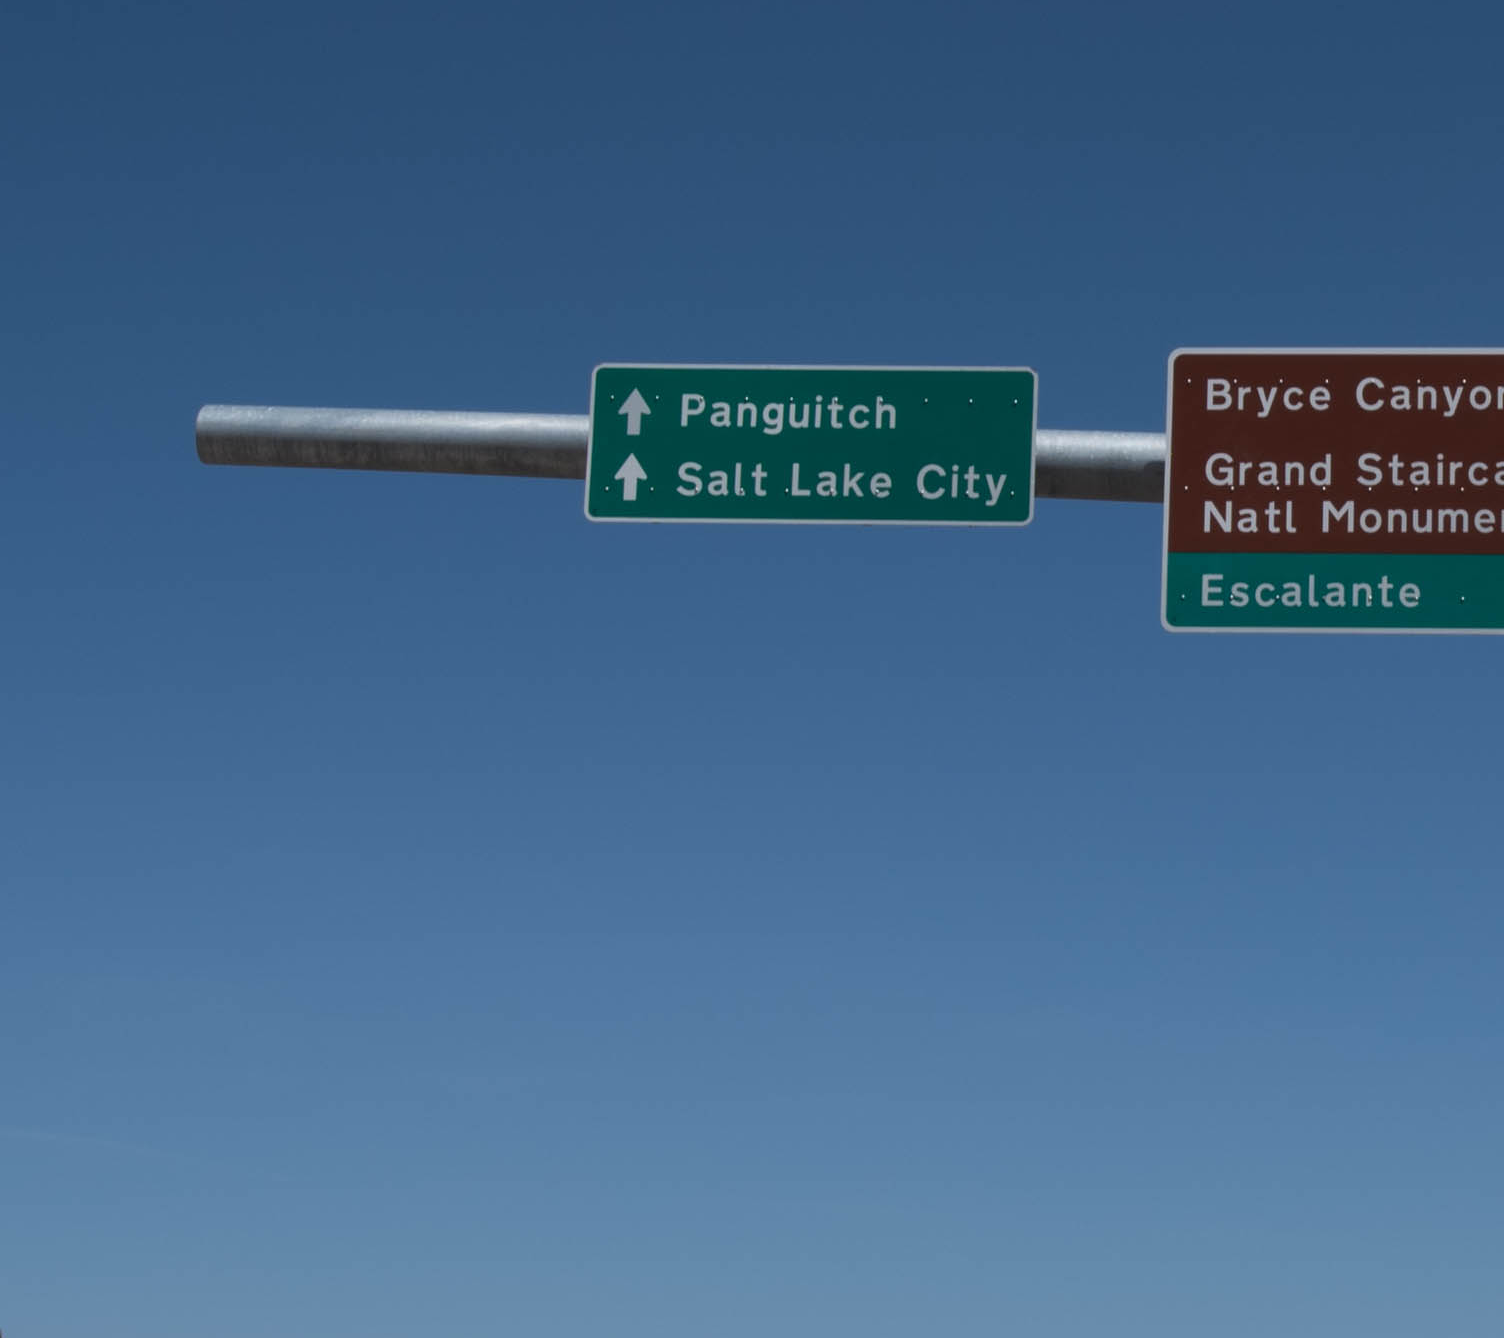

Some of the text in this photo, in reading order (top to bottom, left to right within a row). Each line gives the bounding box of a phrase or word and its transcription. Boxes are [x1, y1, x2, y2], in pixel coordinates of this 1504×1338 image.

[680, 393, 898, 435] Panguitch
[1205, 378, 1332, 418] Bryce
[676, 461, 1008, 506] Salt Lake City
[1204, 452, 1332, 487] Grand
[1203, 500, 1297, 534] Natl
[1200, 573, 1422, 608] Escalante
